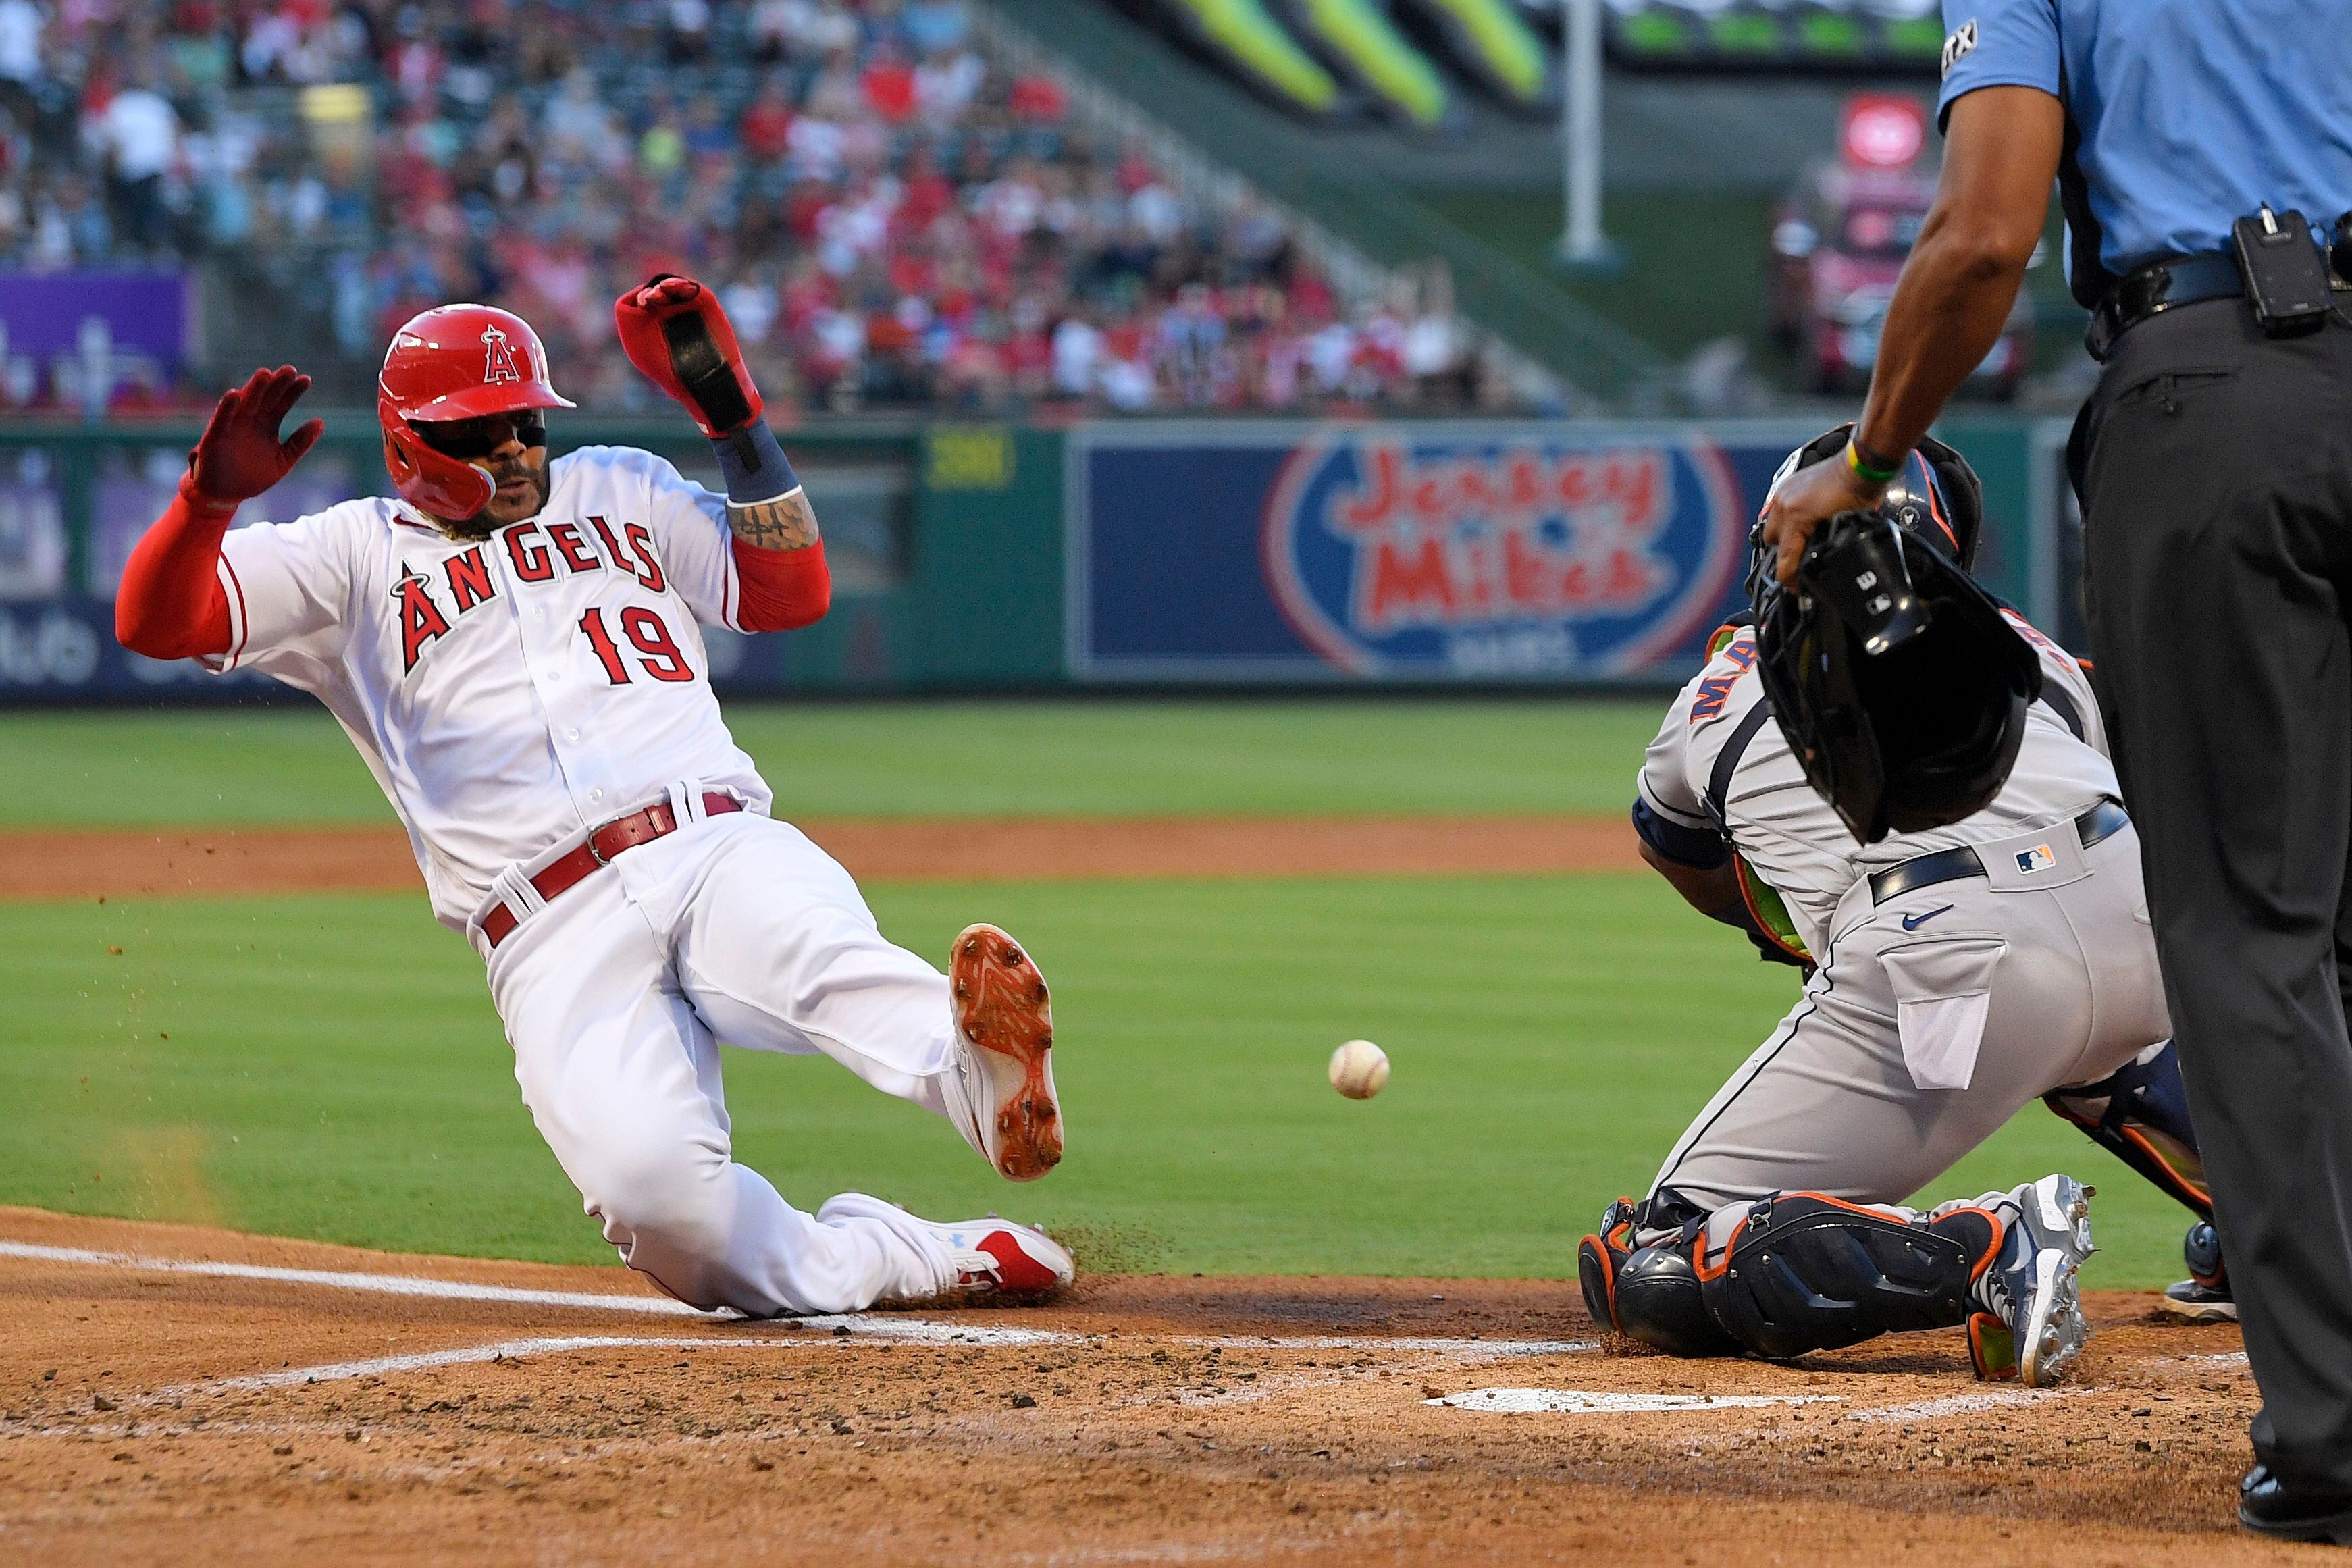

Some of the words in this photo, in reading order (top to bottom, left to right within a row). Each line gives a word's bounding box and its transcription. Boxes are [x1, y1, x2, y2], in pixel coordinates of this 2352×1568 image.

[1942, 22, 1974, 78] TX
[480, 323, 520, 383] A
[390, 514, 667, 677] ANGELS
[579, 606, 695, 685] 19
[1689, 639, 1758, 725] MA
